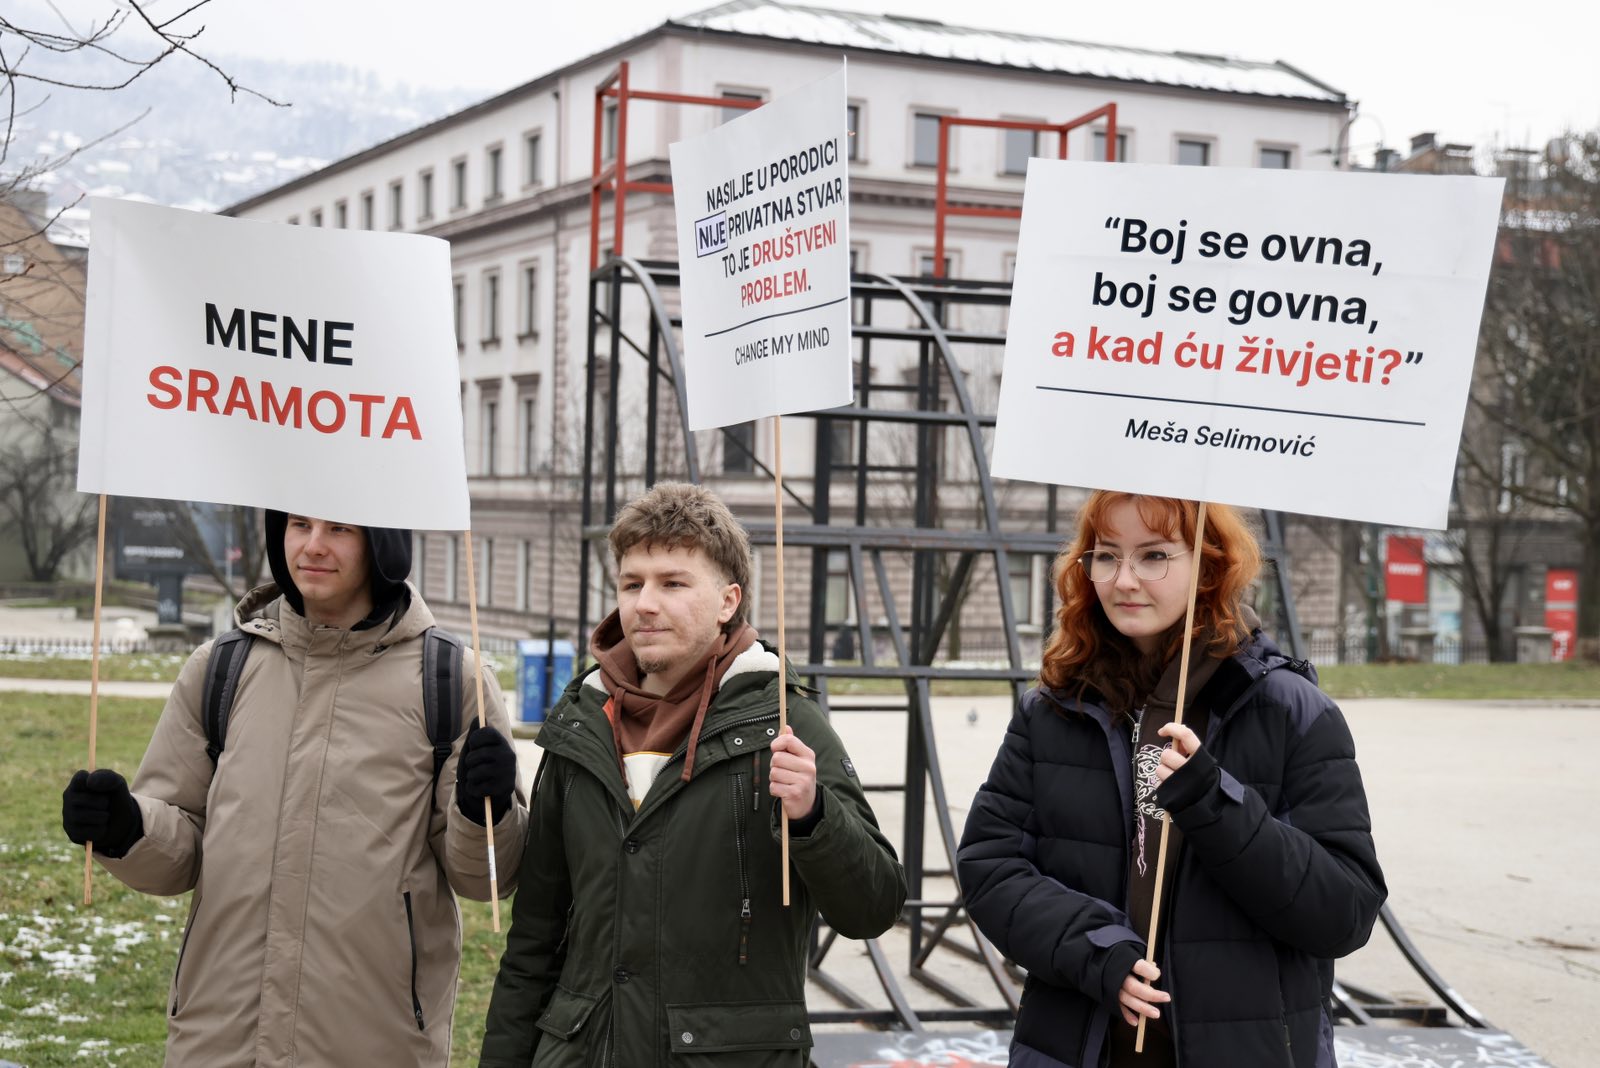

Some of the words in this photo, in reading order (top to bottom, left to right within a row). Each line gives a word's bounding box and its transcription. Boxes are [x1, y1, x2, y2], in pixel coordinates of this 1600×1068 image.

[706, 172, 754, 213] NASILJE
[757, 166, 768, 191] U
[770, 137, 838, 187] PORODICI
[698, 220, 727, 250] NIJE
[728, 195, 795, 240] PRIVATNA
[722, 254, 737, 279] TO
[738, 246, 750, 274] JE
[752, 219, 837, 267] DRUŠTVENI
[1104, 216, 1187, 265] “Boj
[1197, 230, 1249, 260] se
[1260, 233, 1383, 277] ovna,
[740, 268, 812, 308] PROBLEM.
[1092, 271, 1157, 319] boj
[1167, 284, 1217, 314] se
[1227, 288, 1379, 335] govna,
[204, 302, 355, 367] MENE
[734, 338, 769, 367] CHANGE
[771, 333, 794, 356] MY
[797, 326, 830, 352] MIND
[1051, 330, 1075, 358] a
[1086, 325, 1164, 366] kad
[1173, 331, 1225, 371] ću
[1235, 335, 1424, 388] živjeti?”
[146, 365, 423, 441] SRAMOTA
[1124, 418, 1188, 444] Meša
[1193, 425, 1316, 458] Selimović
